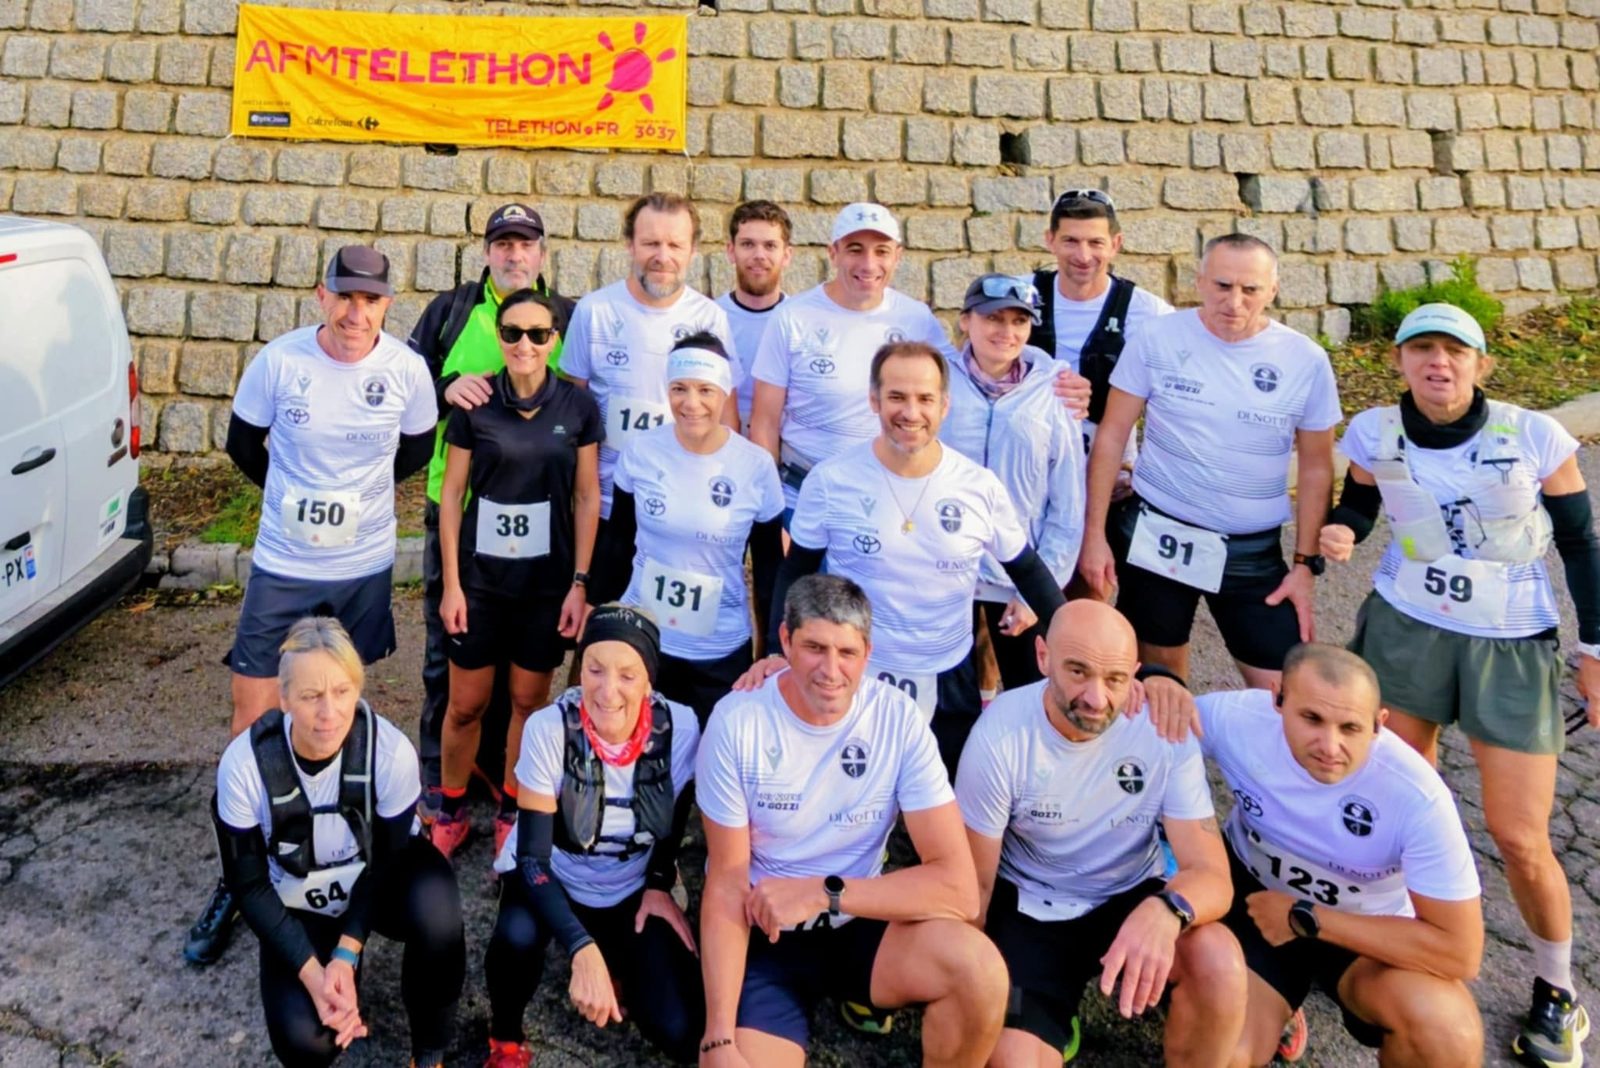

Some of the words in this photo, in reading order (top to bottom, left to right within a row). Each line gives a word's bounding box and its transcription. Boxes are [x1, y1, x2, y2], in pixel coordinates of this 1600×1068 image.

[635, 122, 676, 142] 3637
[295, 498, 345, 526] 150
[496, 514, 529, 537] 38
[1158, 534, 1194, 566] 91
[655, 575, 703, 611] 131
[1424, 566, 1472, 603] 59
[1265, 854, 1340, 906] 123
[305, 881, 348, 910] 64
